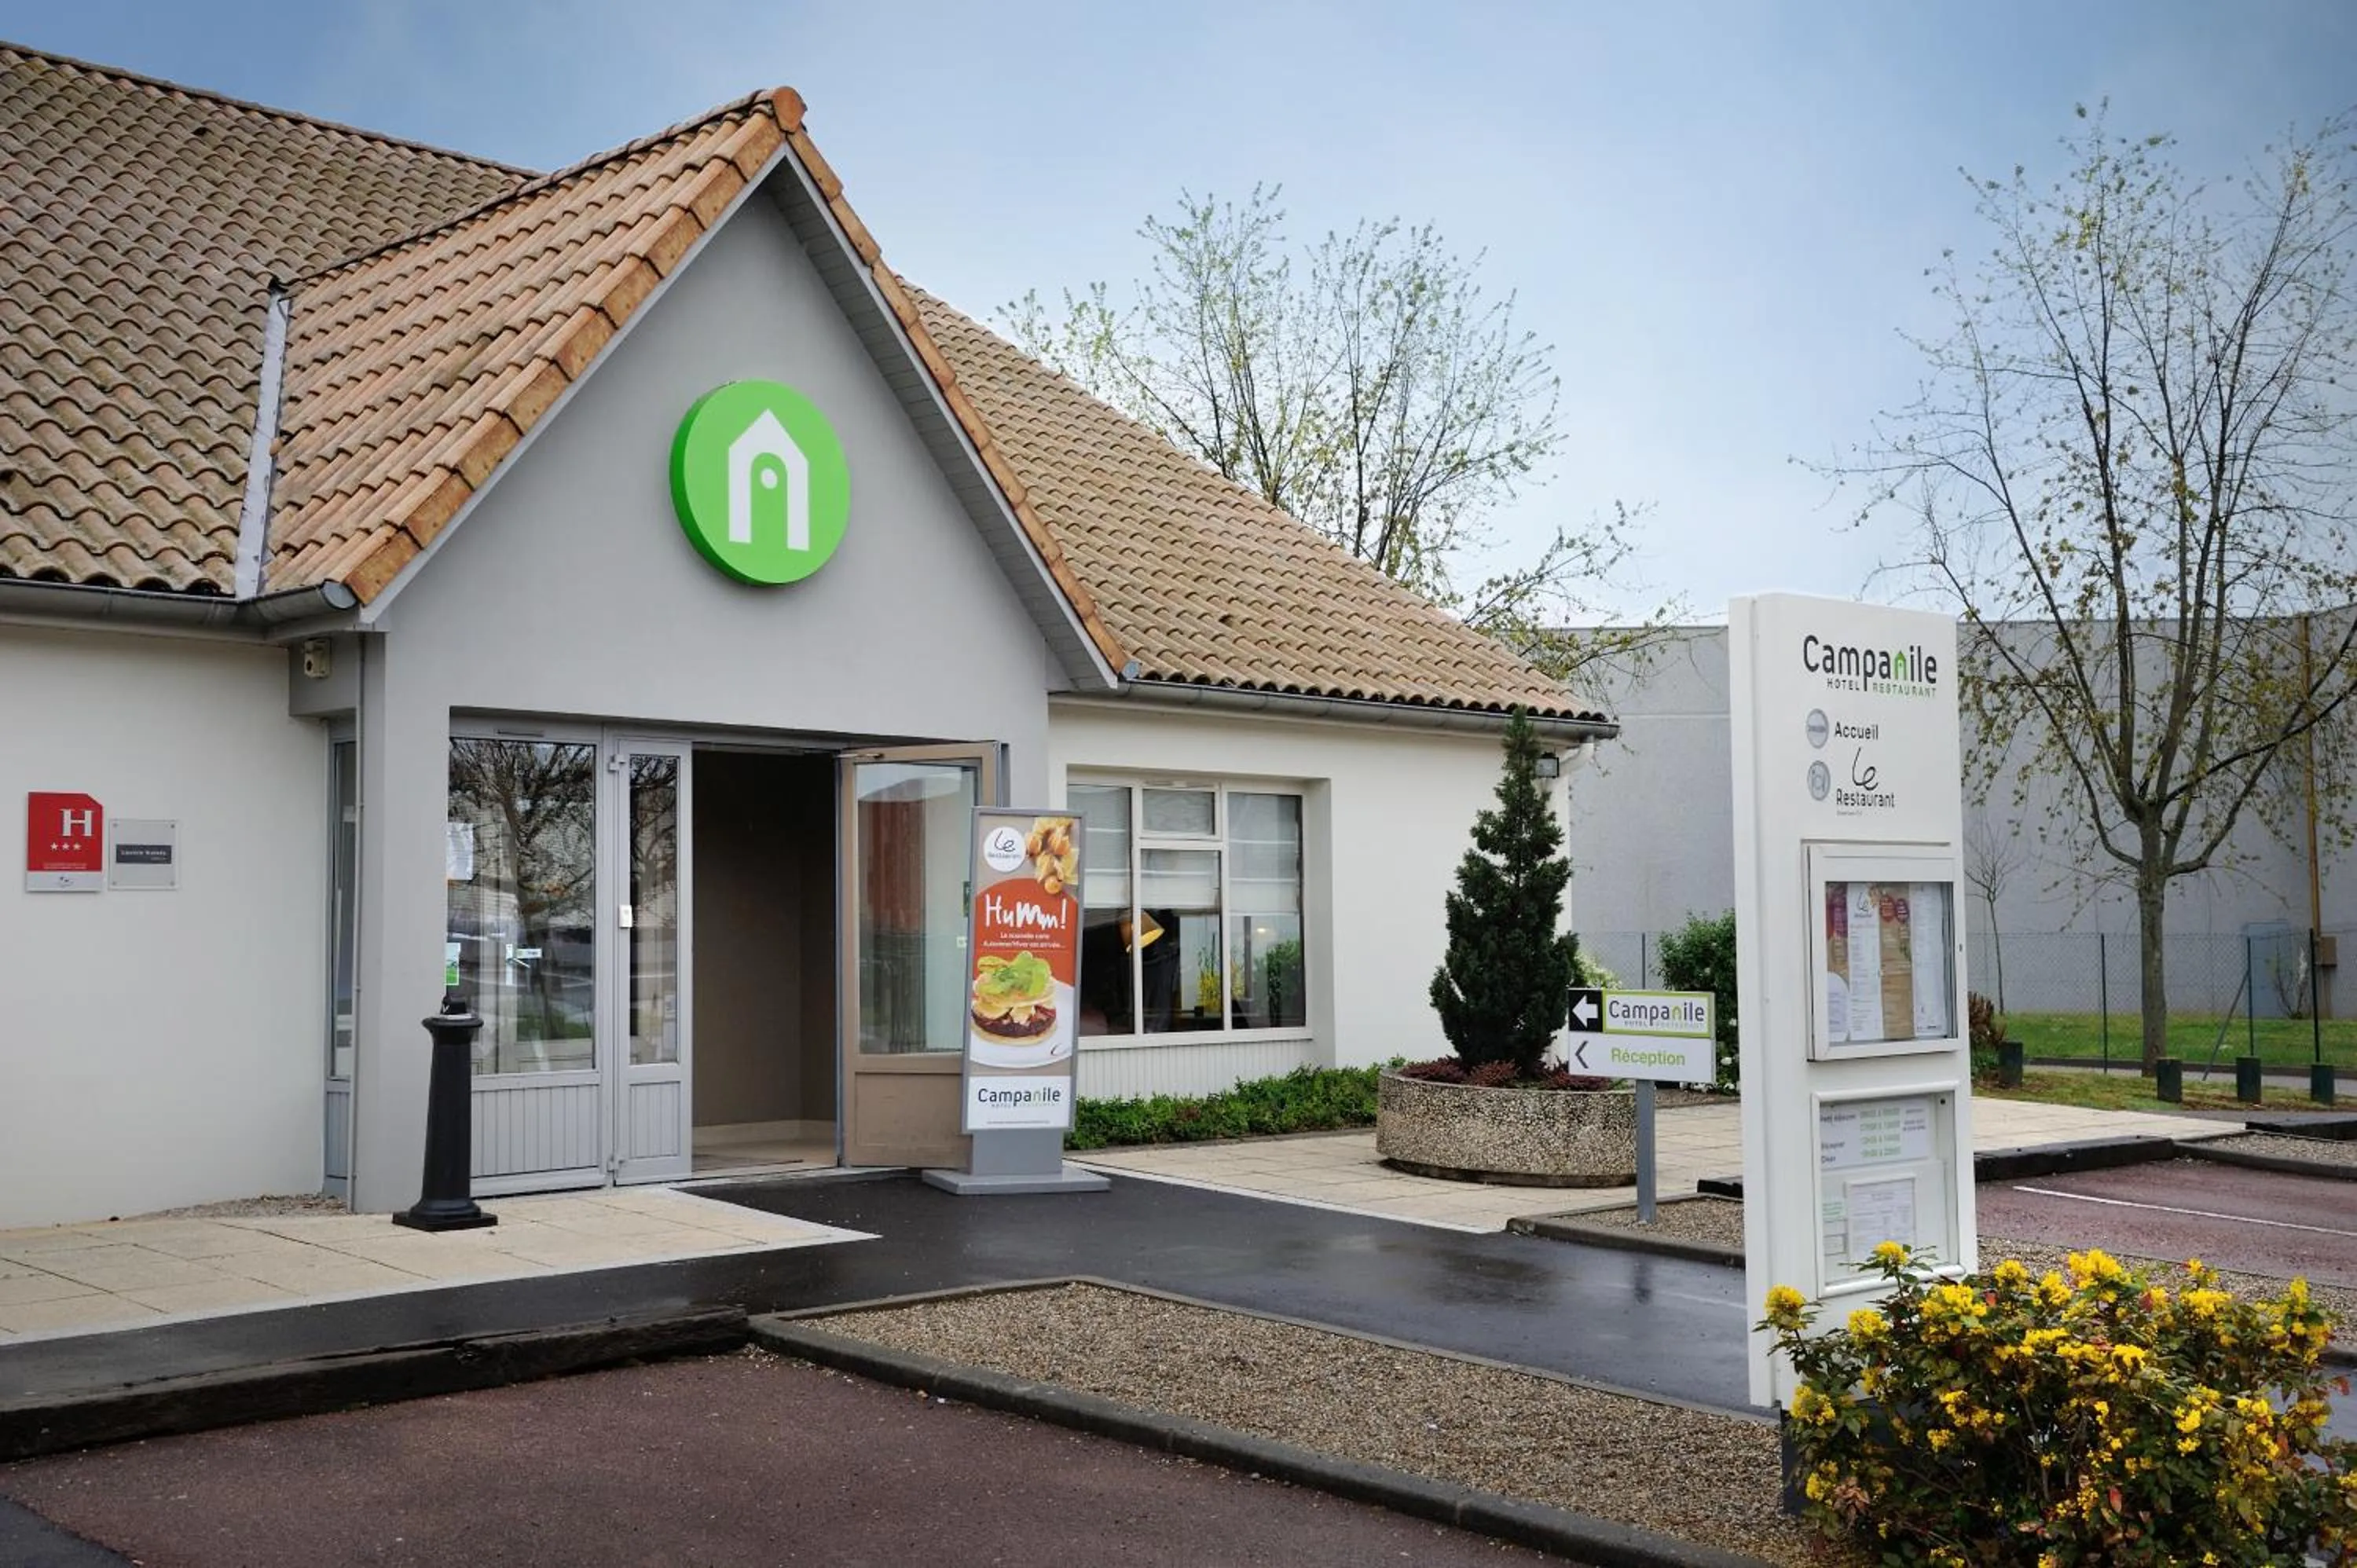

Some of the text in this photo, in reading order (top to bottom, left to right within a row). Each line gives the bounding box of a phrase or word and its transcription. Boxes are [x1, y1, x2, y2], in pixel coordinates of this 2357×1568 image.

[1803, 635, 1937, 691] Campanile
[1827, 678, 1937, 698] HOTEL RESTAURANT
[1835, 720, 1879, 740] Accueil
[1836, 788, 1895, 808] Restaurant
[60, 808, 94, 837] H
[1608, 1000, 1705, 1027] Campanile
[1611, 1047, 1686, 1068] Réception
[978, 1087, 1061, 1107] Campanile
